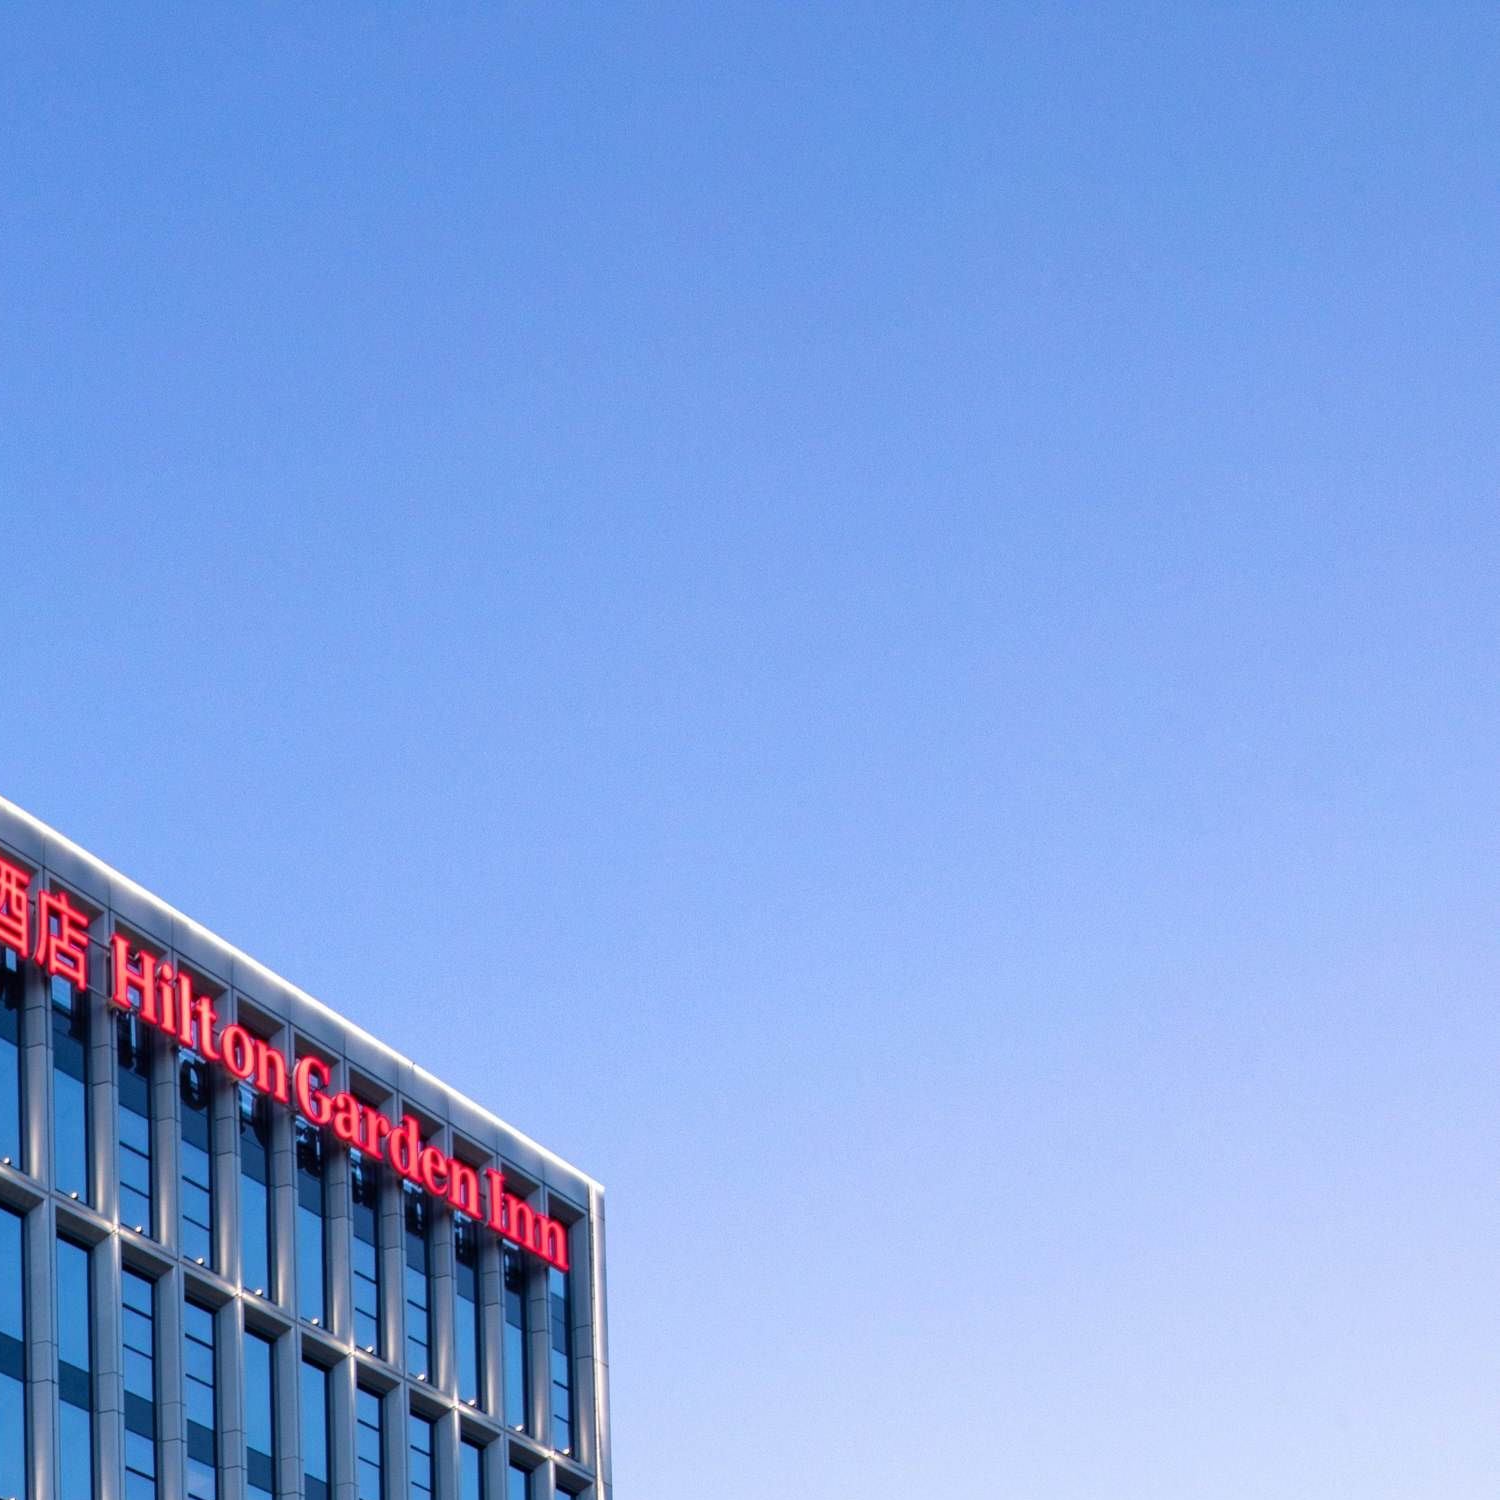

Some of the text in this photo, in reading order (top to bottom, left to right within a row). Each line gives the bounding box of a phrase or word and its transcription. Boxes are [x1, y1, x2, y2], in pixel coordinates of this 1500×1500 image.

[110, 932, 570, 1272] Hilton Garden Inn
